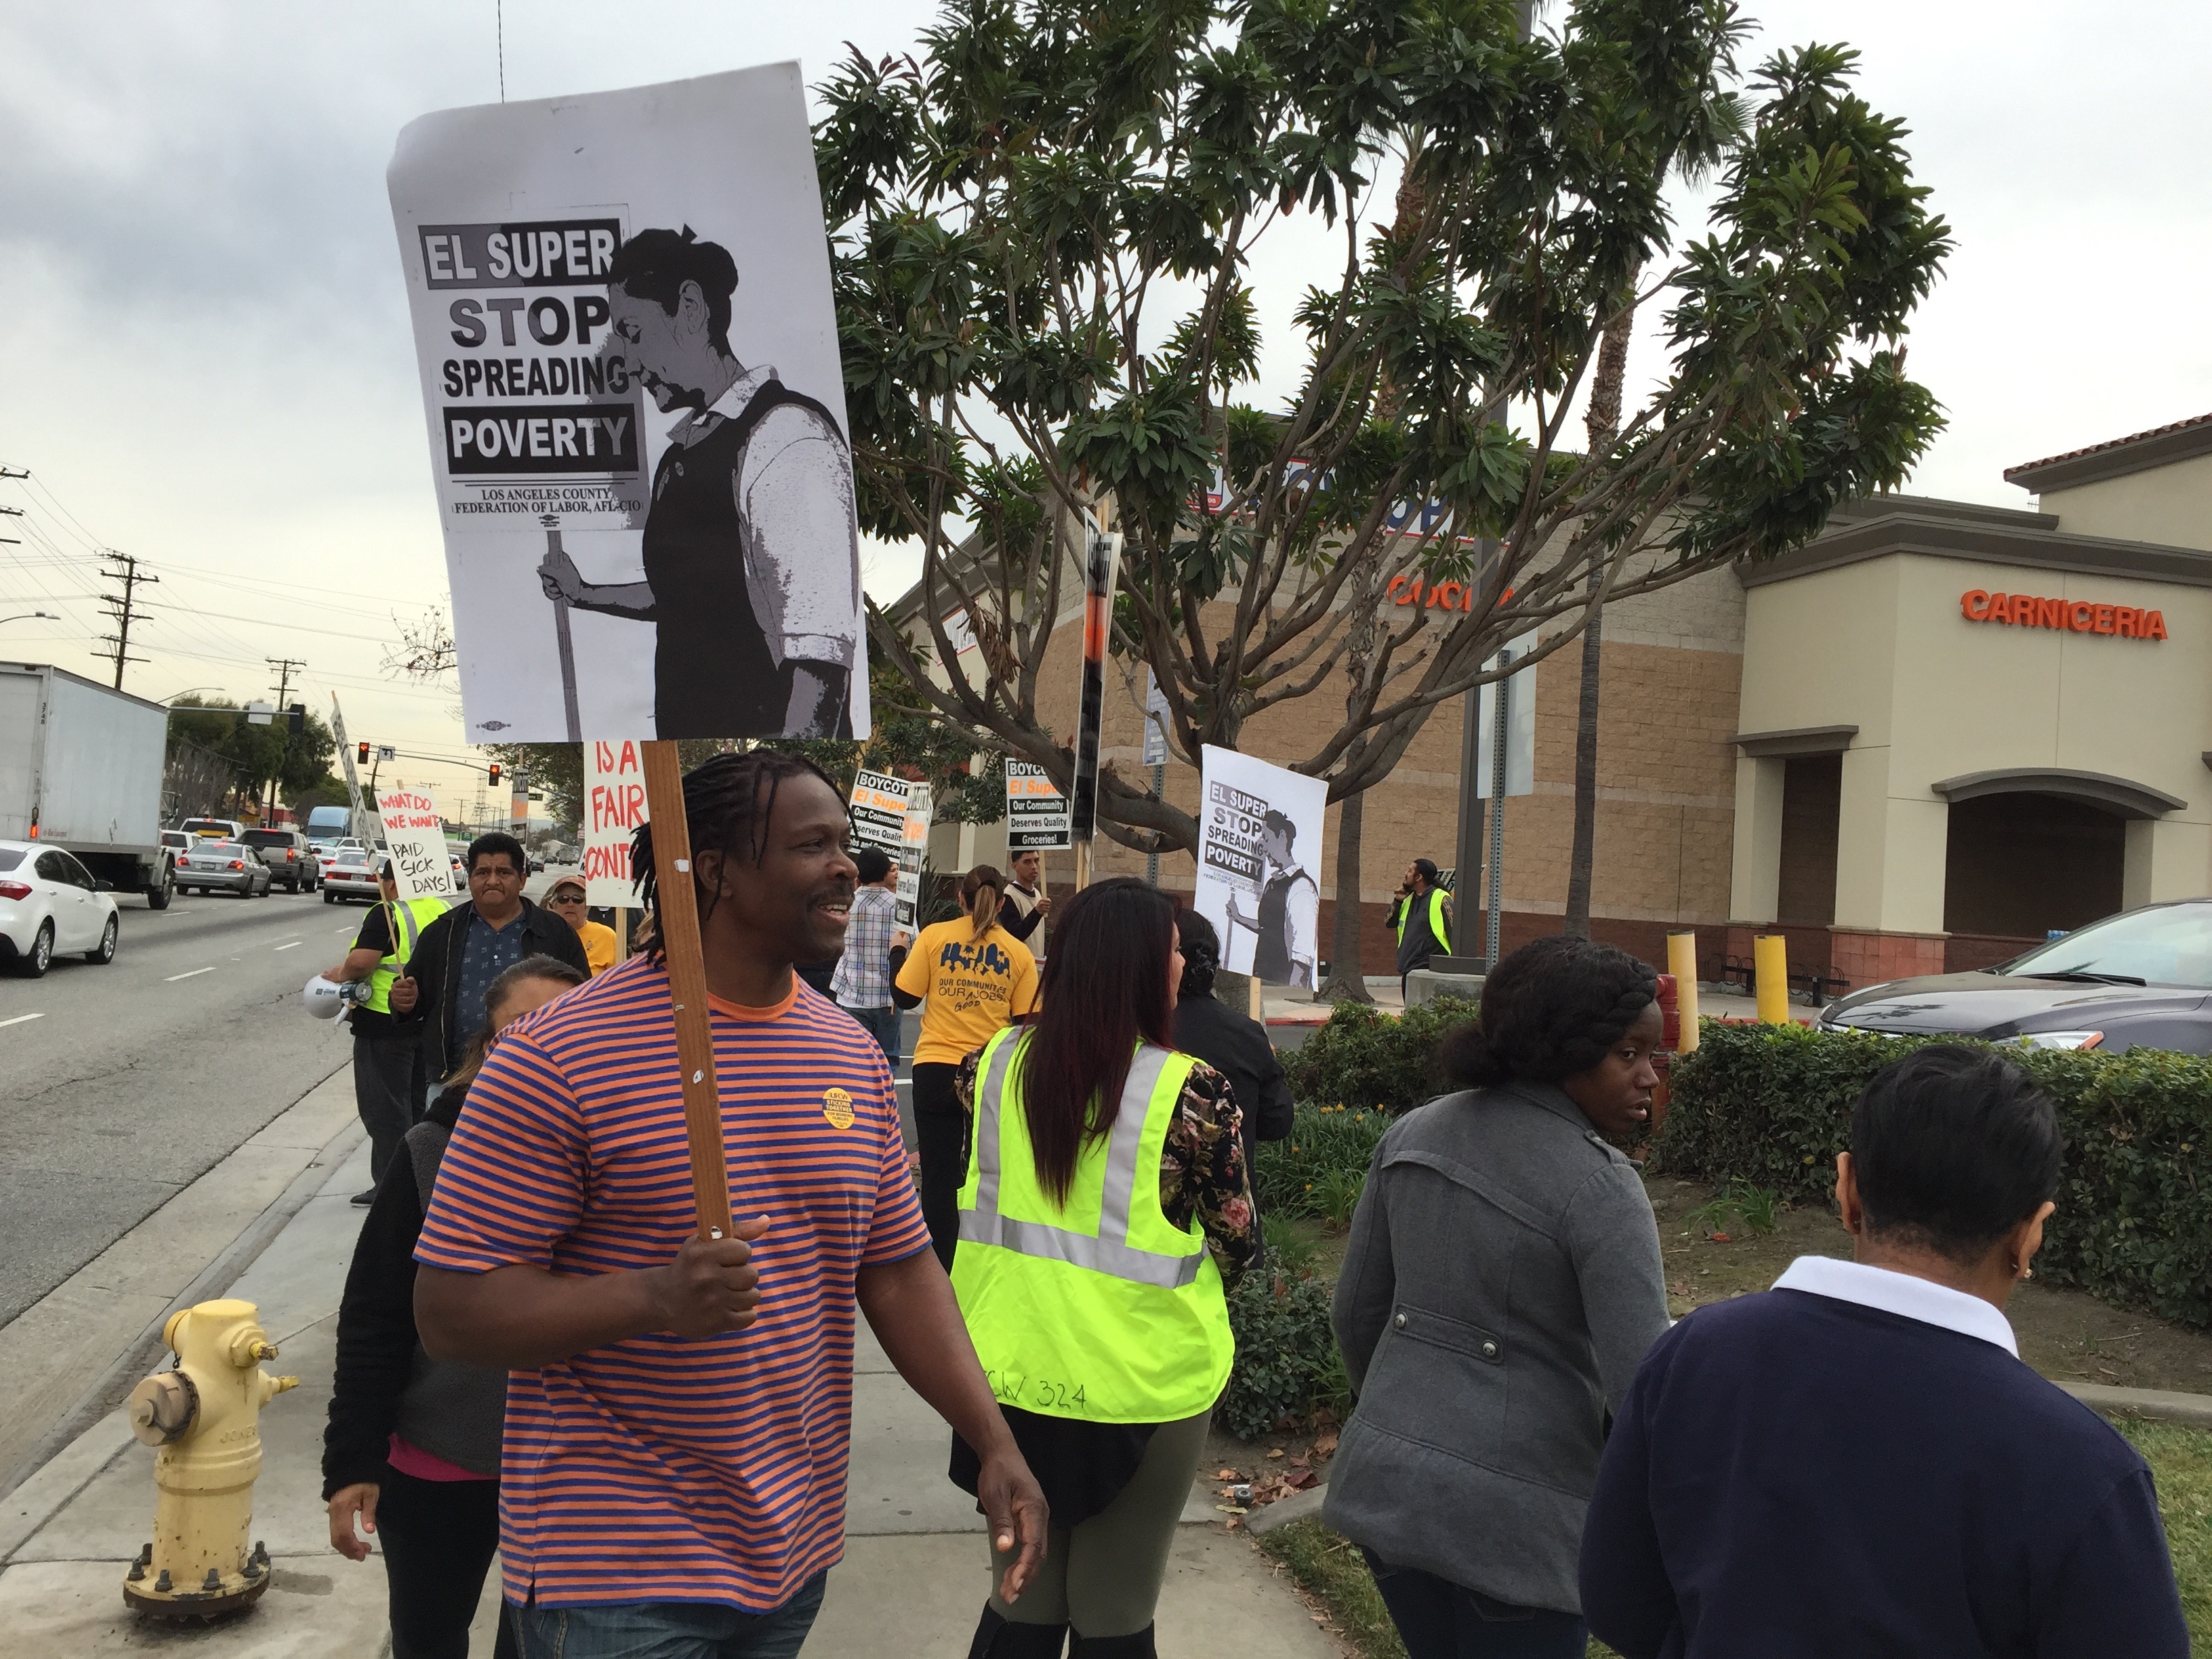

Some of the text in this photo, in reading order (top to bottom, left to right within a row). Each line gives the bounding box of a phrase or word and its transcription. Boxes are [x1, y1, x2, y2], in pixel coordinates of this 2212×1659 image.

[424, 229, 614, 280] EL SUPER
[449, 295, 611, 348] STOP
[443, 355, 630, 398] SPREADING
[451, 417, 628, 459] POVERTY
[481, 488, 611, 501] LOS ANGELES COUNTY
[455, 500, 641, 514] FEDERATION OF LABOR, AFL-CIO
[1960, 589, 2168, 640] CARNICERIA
[596, 741, 638, 775] IS A
[859, 773, 907, 795] BOYCOT
[1009, 779, 1023, 794] El
[379, 793, 432, 811] WHAT DO
[592, 784, 644, 833] FAIR
[854, 788, 869, 802] El
[872, 793, 907, 812] Supe
[1012, 800, 1063, 812] Our Community
[1211, 783, 1267, 818] EL SUPER
[384, 815, 406, 830] WE
[854, 807, 903, 827] Our Communit
[1011, 817, 1067, 828] Deserves Quality
[1214, 806, 1262, 837] STOP
[882, 830, 902, 842] Qualit
[1022, 834, 1058, 845] Groceries!
[1208, 825, 1264, 857] SPREADING
[391, 842, 424, 859] PAID
[1206, 844, 1261, 876] POVERTY
[401, 857, 434, 877] SICK
[586, 843, 634, 881] CONT
[413, 871, 451, 893] DAYS!
[939, 978, 954, 986] OUR
[939, 987, 966, 996] OUR
[1037, 1380, 1086, 1409] 324
